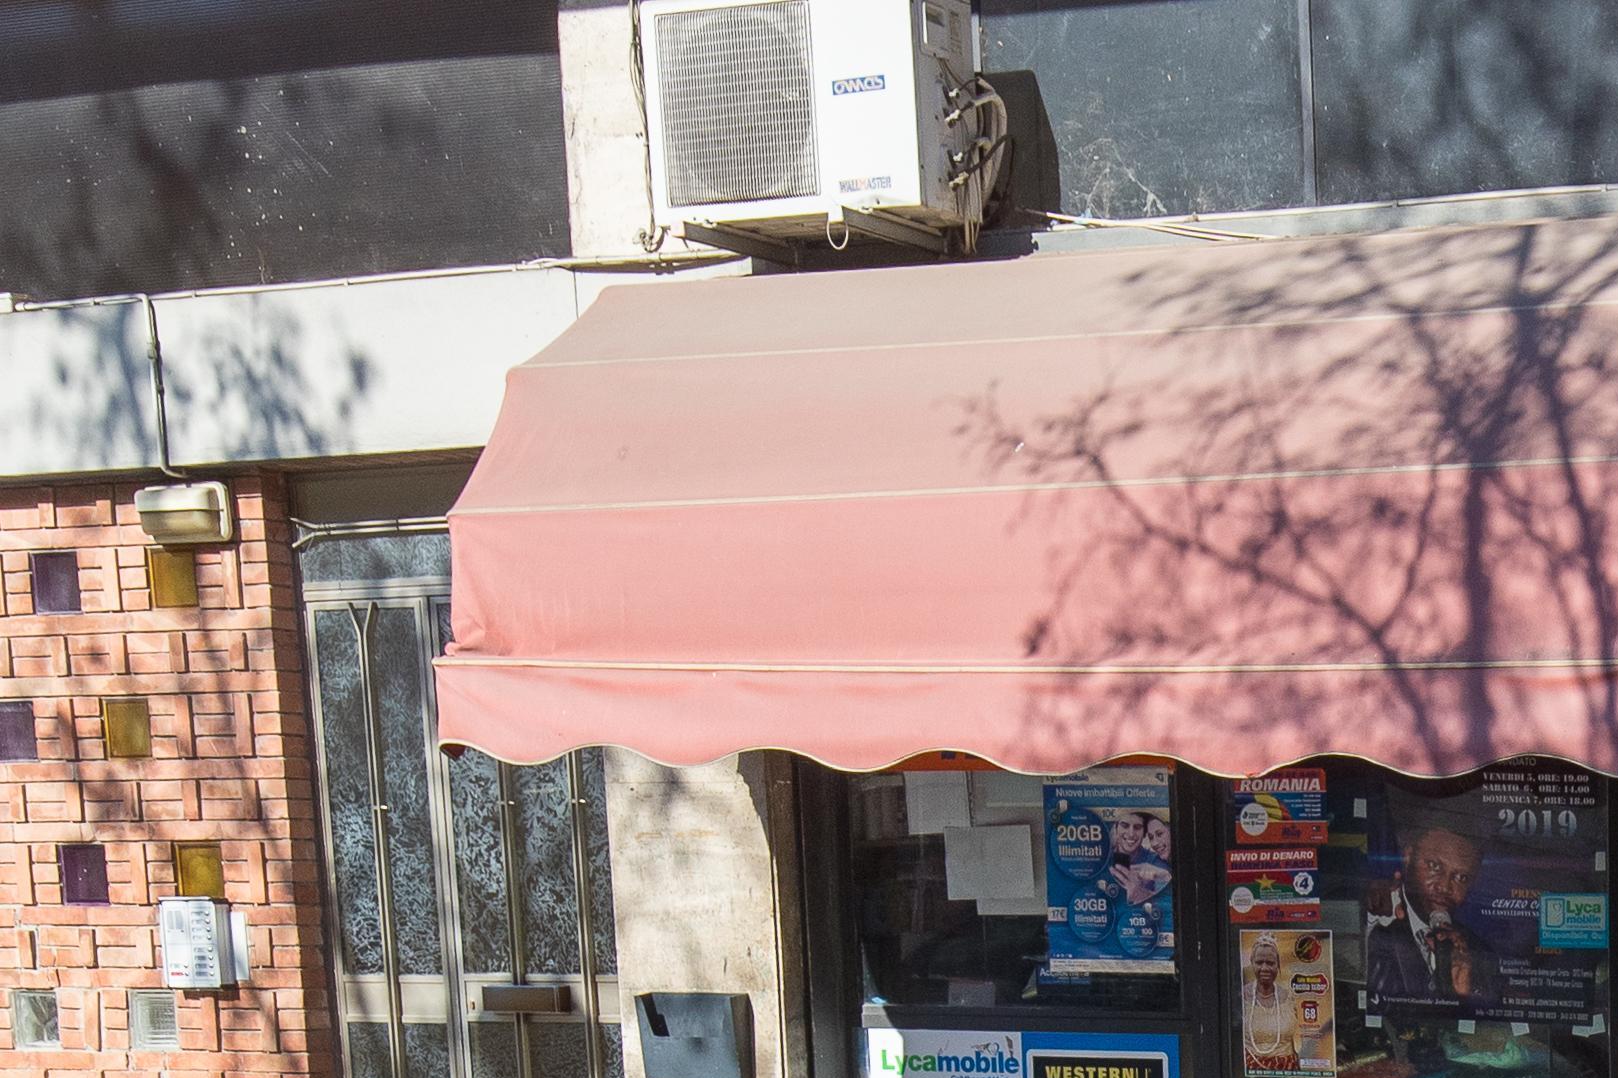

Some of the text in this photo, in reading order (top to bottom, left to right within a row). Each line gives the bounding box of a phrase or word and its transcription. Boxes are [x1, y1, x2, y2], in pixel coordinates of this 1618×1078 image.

[838, 175, 893, 193] WALLMASTER
[1482, 772, 1525, 781] VENERDI
[1538, 774, 1560, 782] ORE:
[1563, 774, 1590, 783] 19.00
[1240, 778, 1321, 792] ROMANIA
[1482, 783, 1519, 792] SABATO
[1538, 785, 1561, 793] ORE:
[1564, 785, 1590, 793] 14.00
[1055, 788, 1082, 798] Nuove
[1482, 795, 1530, 804] DOMENICA
[1544, 796, 1566, 804] ORE:
[1569, 797, 1595, 805] 18.00
[1498, 808, 1577, 837] 2019
[1057, 825, 1102, 841] 20GB
[1058, 845, 1102, 857] Illimitati
[1230, 850, 1314, 861] INVIO DI DENARO
[1074, 898, 1107, 911] 30GB
[1491, 899, 1528, 910] CENTRO
[1566, 900, 1601, 916] Lyca
[1050, 909, 1066, 919] 17€
[1566, 914, 1601, 924] mobile
[1129, 917, 1146, 926] 1GB
[1304, 1007, 1316, 1020] 68
[881, 1049, 1020, 1076] Lycamobile
